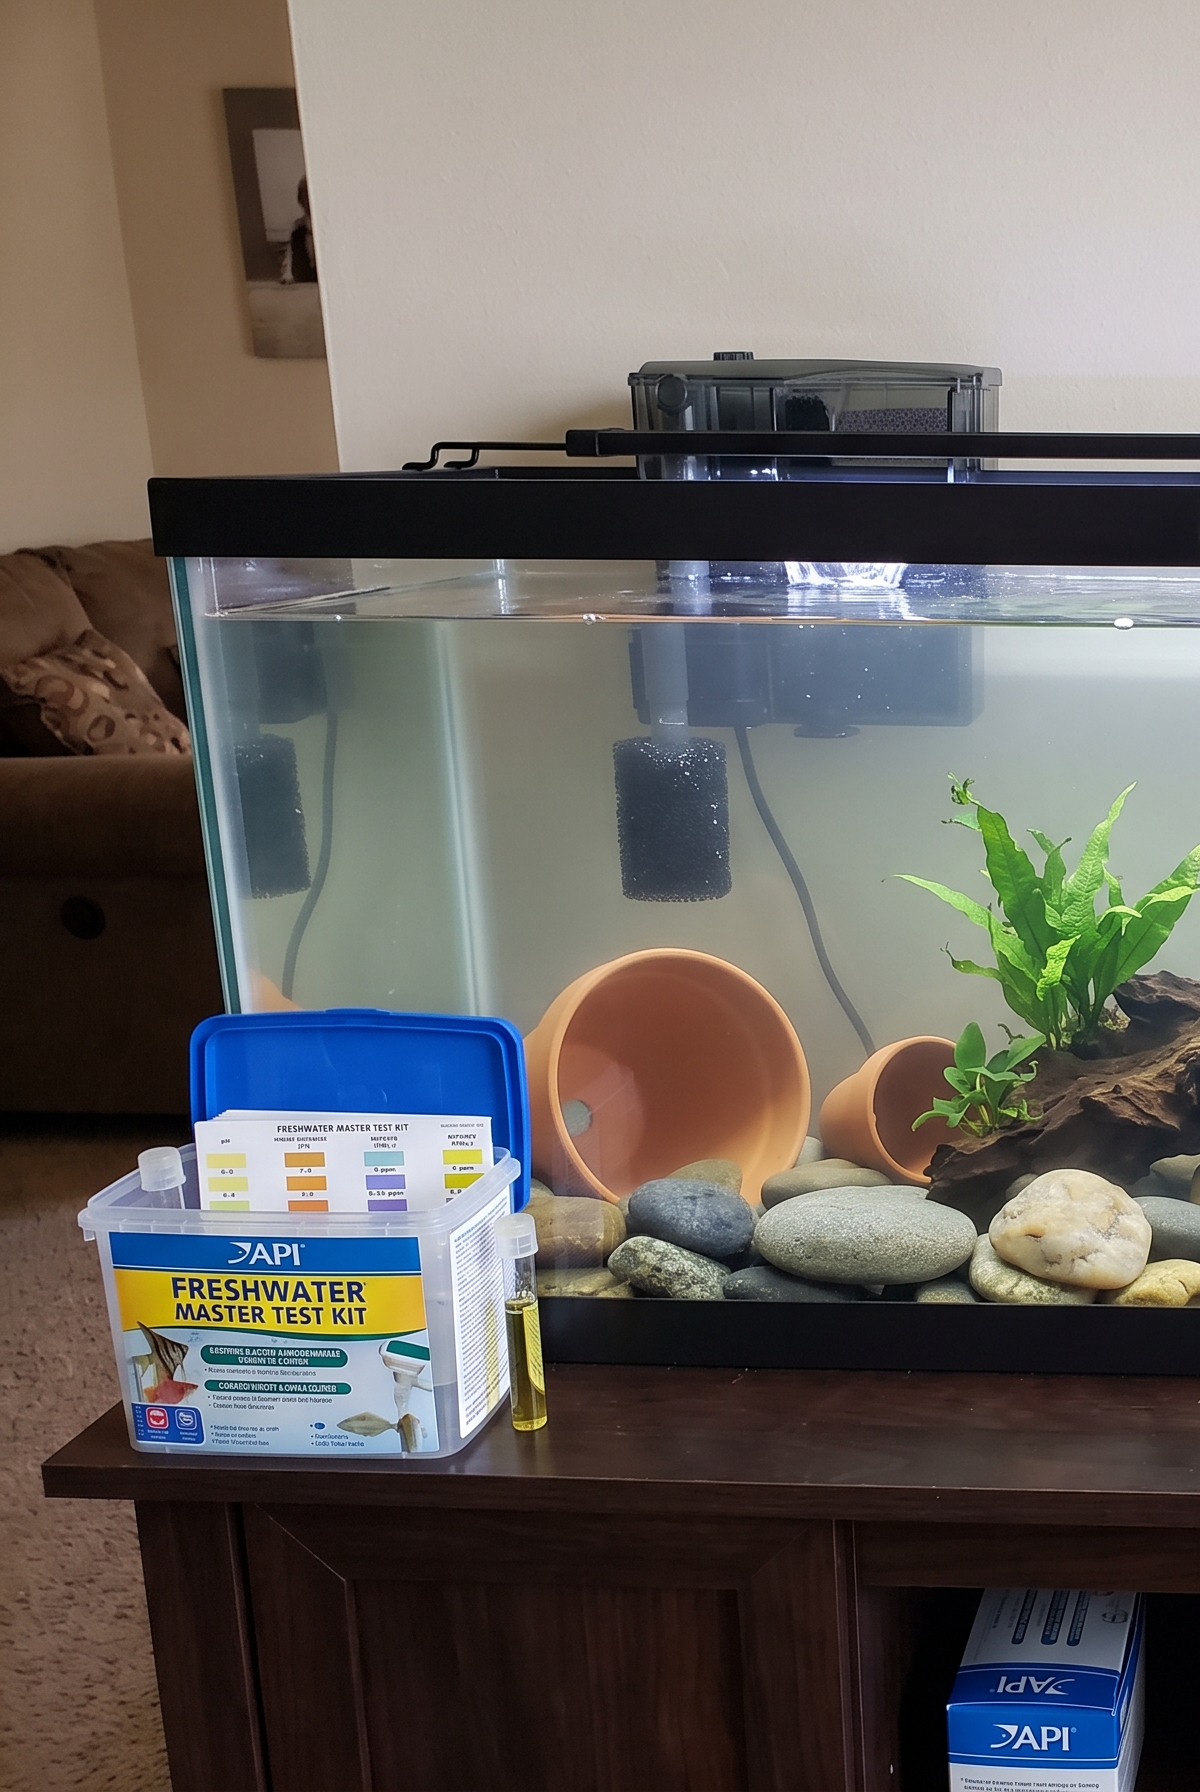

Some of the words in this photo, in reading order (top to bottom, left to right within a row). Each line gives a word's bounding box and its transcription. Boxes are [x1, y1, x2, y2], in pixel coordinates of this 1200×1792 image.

[277, 1124, 334, 1134] FRESHWATER
[336, 1124, 371, 1133] MASTER
[373, 1123, 393, 1132] TEST
[394, 1123, 409, 1131] KIT
[248, 1242, 302, 1266] API
[171, 1276, 367, 1303] FRESHWATER
[175, 1303, 266, 1324] MASTER
[271, 1306, 325, 1325] TEST
[332, 1307, 367, 1325] KIT
[1011, 1725, 1071, 1751] API
